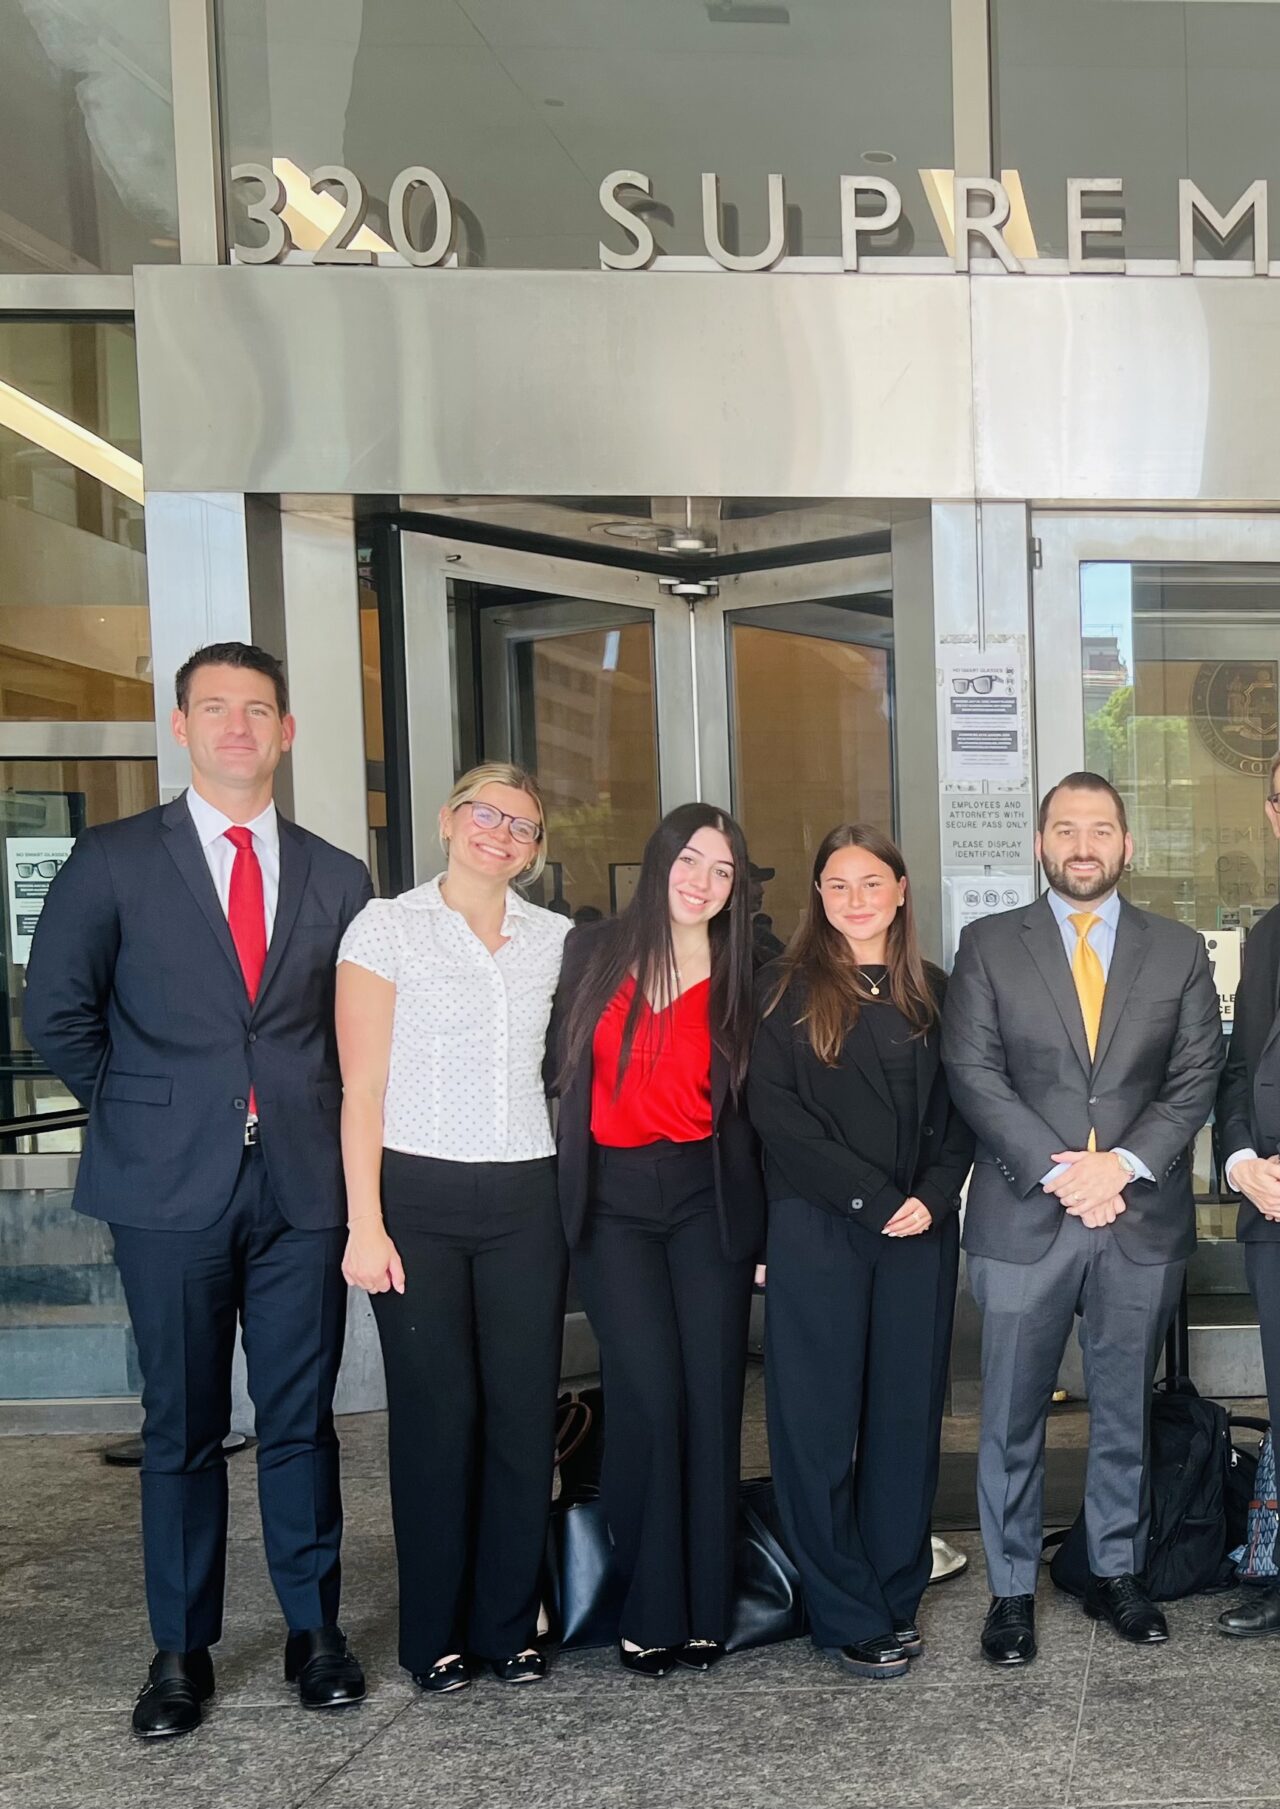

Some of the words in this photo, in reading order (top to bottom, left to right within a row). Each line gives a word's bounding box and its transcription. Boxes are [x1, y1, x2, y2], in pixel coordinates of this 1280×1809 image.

[231, 163, 452, 267] 320
[951, 801, 1001, 809] EMPLOYEES
[1004, 801, 1021, 809] AND
[949, 811, 1000, 819] ATTORNEY'S
[1003, 811, 1025, 819] WITH
[945, 820, 978, 829] SECURE
[981, 820, 1003, 829] PASS
[1006, 820, 1028, 829] ONLY
[952, 840, 984, 848] PLEASE
[987, 840, 1022, 848] DISPLAY
[954, 850, 1021, 858] IDENTIFICATION
